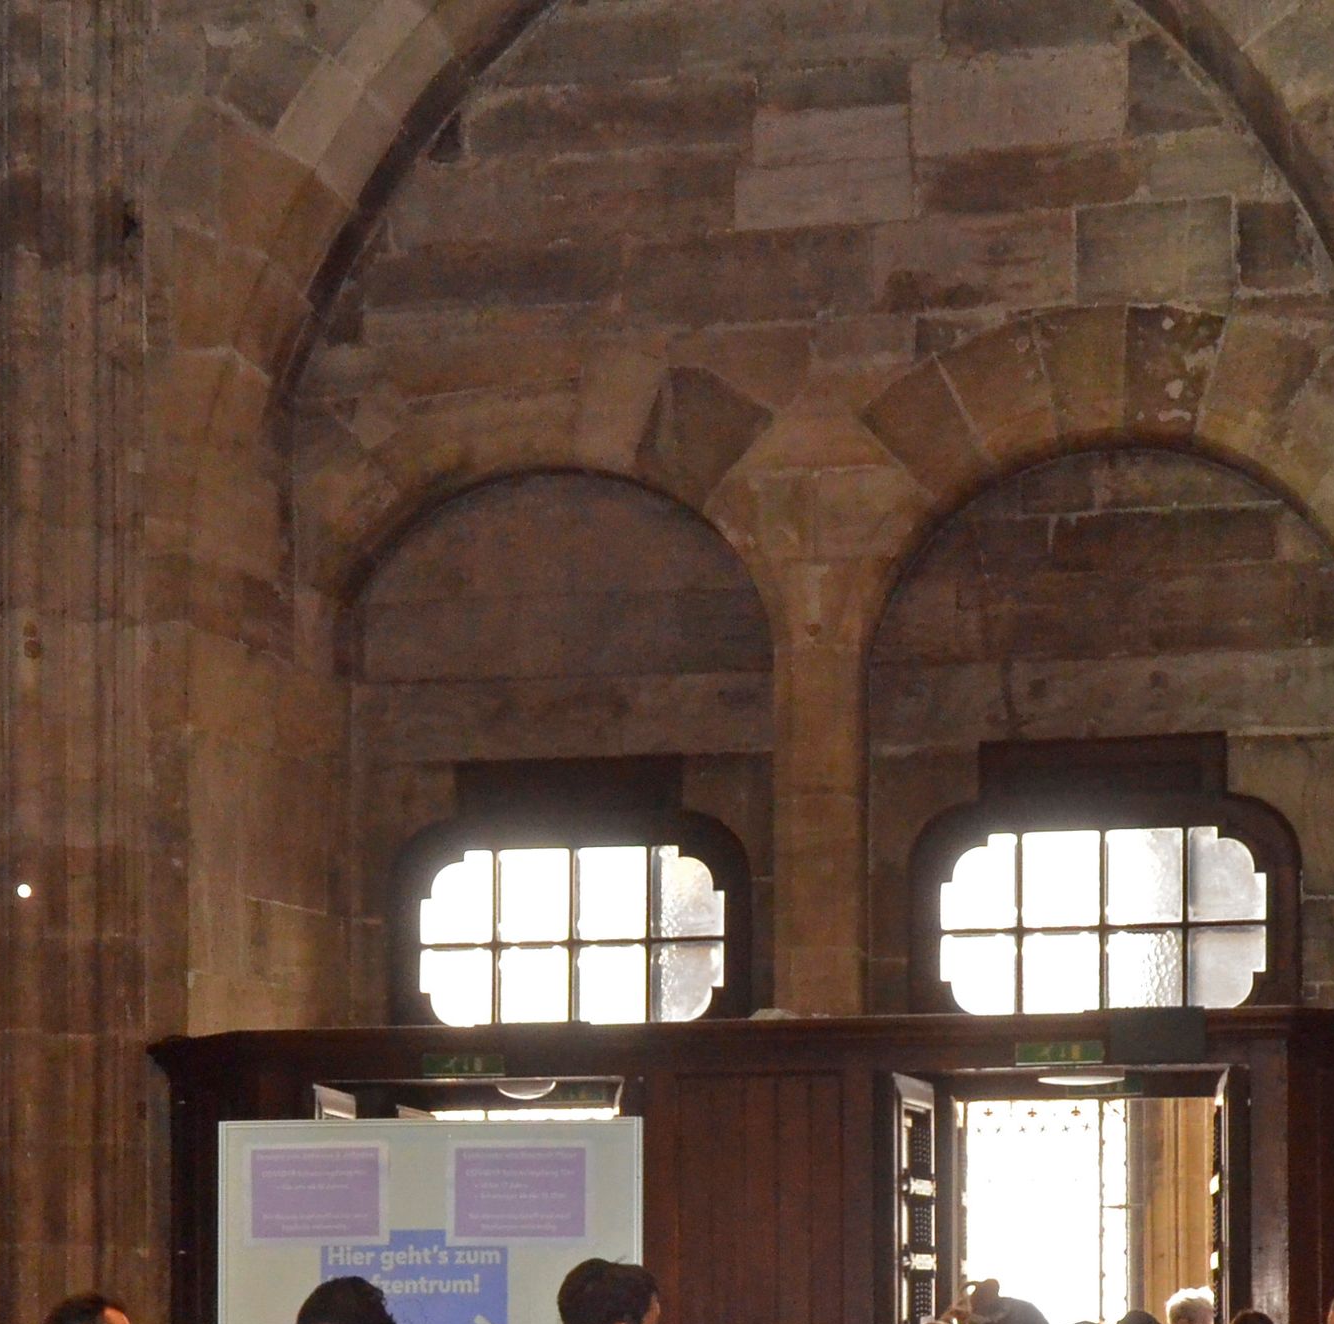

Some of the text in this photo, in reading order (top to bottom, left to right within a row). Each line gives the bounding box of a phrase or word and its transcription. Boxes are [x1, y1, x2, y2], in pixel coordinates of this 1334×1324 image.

[327, 1245, 501, 1271] Hier geht's zum
